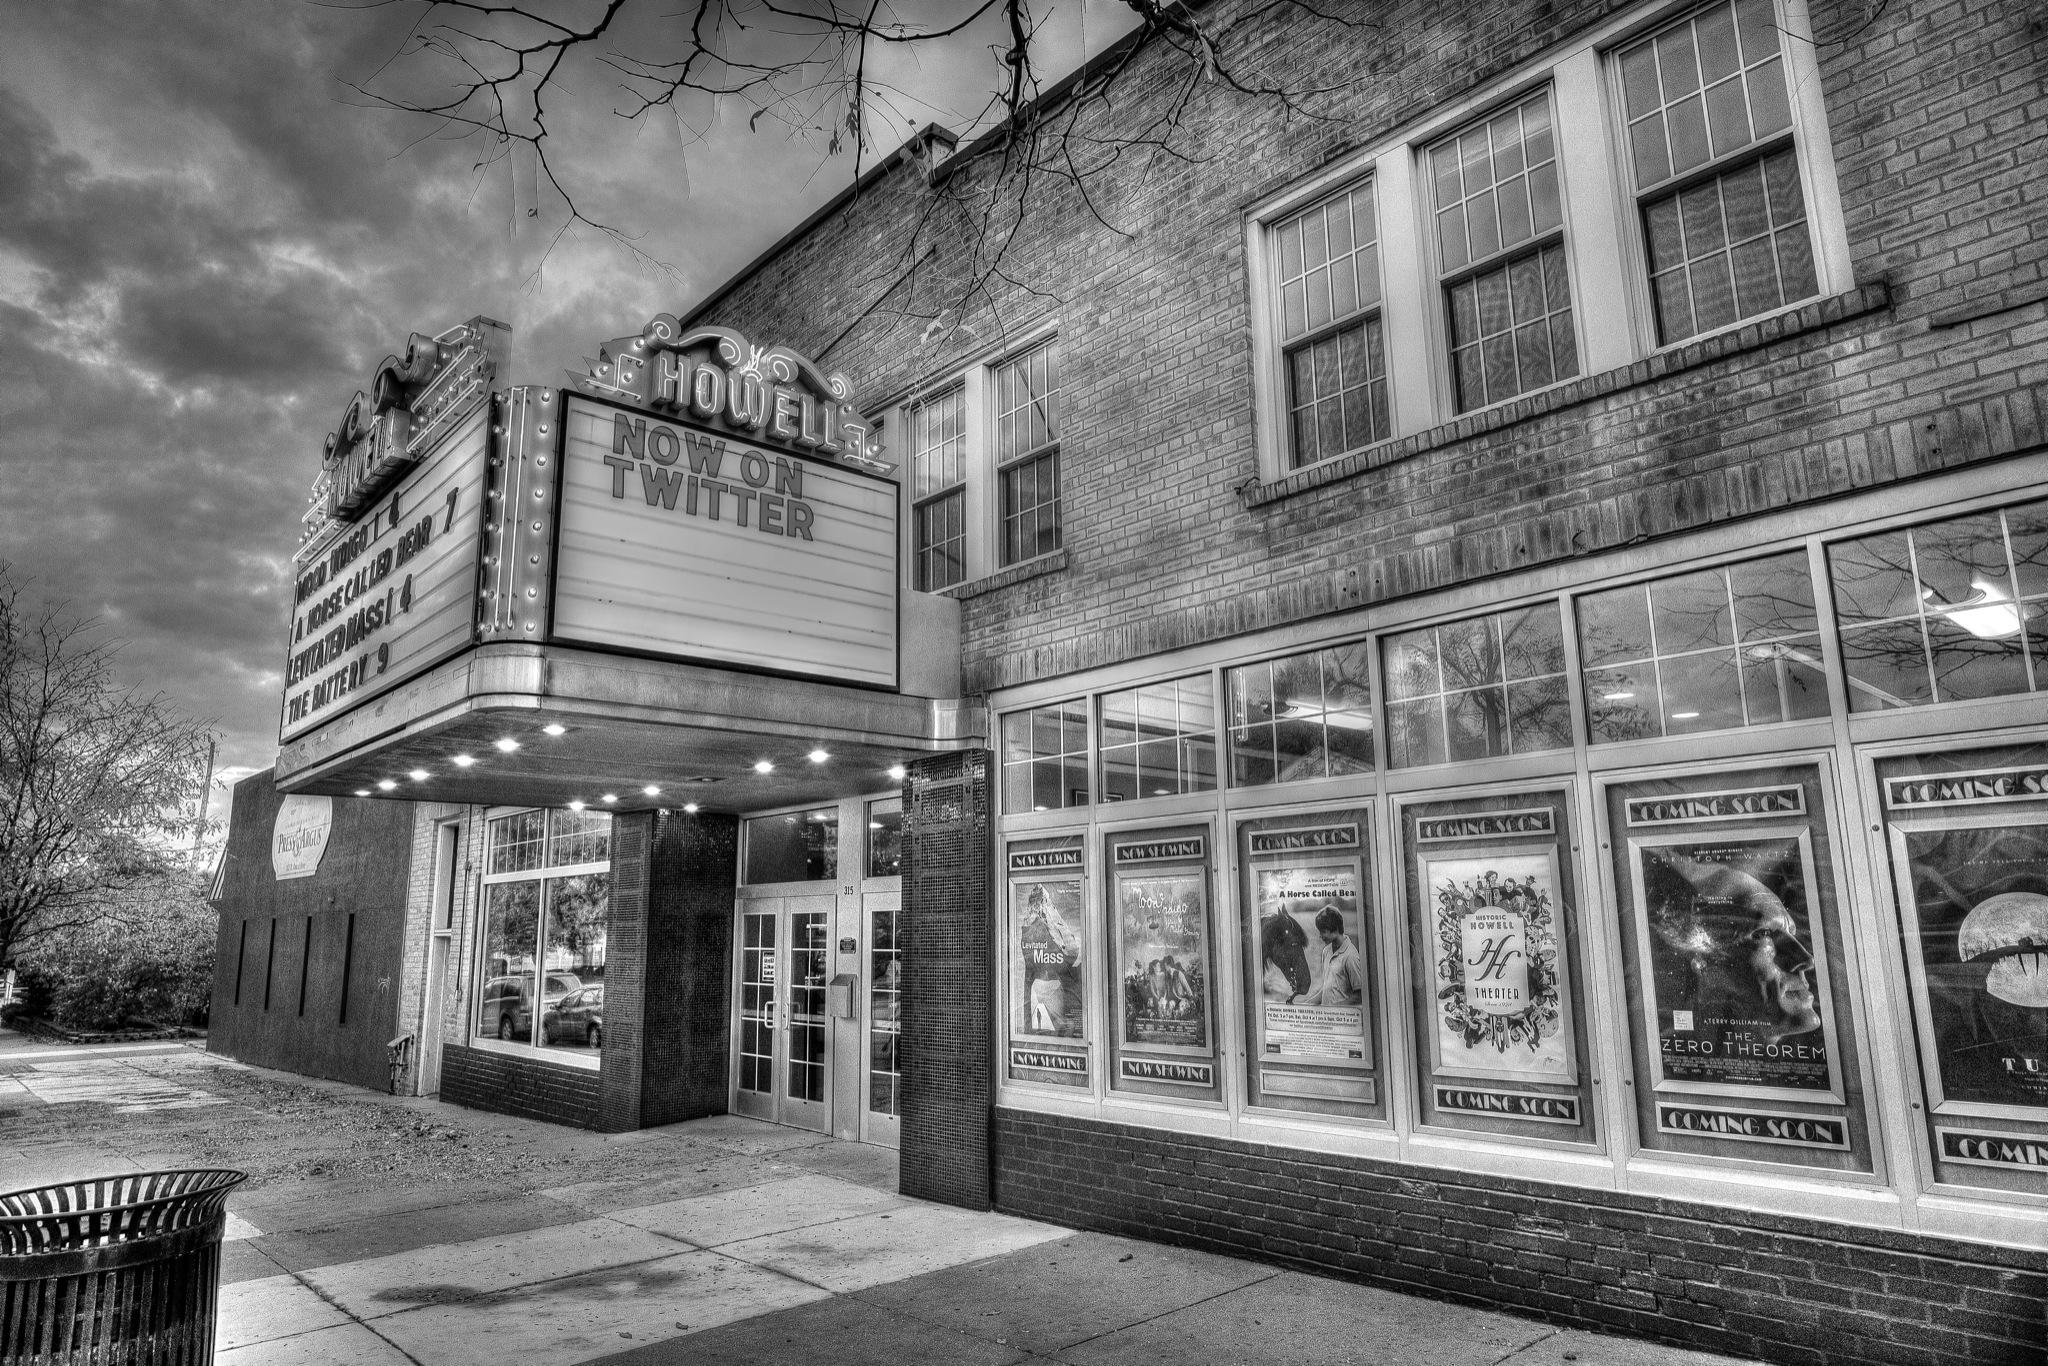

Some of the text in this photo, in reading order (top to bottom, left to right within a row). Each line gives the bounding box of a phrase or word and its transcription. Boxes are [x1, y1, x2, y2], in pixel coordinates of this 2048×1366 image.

[652, 349, 846, 452] HOWELL
[613, 412, 803, 500] NOW ON
[604, 455, 815, 542] TWITTER
[297, 561, 327, 605] MOOD
[330, 525, 369, 581] INDIGO
[388, 491, 400, 528] 4
[295, 617, 303, 644] A
[307, 585, 344, 636] HORSE
[344, 547, 394, 606] CALLED
[396, 515, 433, 569] BEAR
[286, 624, 346, 689] LEVITATED
[345, 598, 385, 652] MASS
[400, 573, 413, 614] 4
[289, 642, 389, 725] THE BATTERY 9
[1902, 777, 2015, 803] COMING
[1640, 794, 1794, 821] COMING SOON
[1426, 816, 1543, 838] COMING SOON
[1257, 830, 1351, 850] COMING SOON
[1016, 852, 1080, 867] NOW SHOWING
[1122, 842, 1200, 859] NOW SHOWING
[1651, 851, 1790, 864] CHRISTOPH WALTZ
[844, 886, 854, 896] 315
[1287, 890, 1310, 898] Horse
[1312, 889, 1337, 897] Called
[1470, 921, 1515, 930] HOWELL
[1022, 941, 1048, 950] Levitated
[1033, 949, 1064, 964] Mass
[1474, 987, 1520, 1000] THEATER
[1725, 1031, 1752, 1042] THE
[1661, 1039, 1826, 1060] ZERO THEOREM
[1017, 1053, 1085, 1070] NOW SHOWING
[1128, 1062, 1208, 1080] NOW SHOWING
[1445, 1090, 1570, 1118] COMING SOON
[1668, 1111, 1833, 1143] COMING SOON
